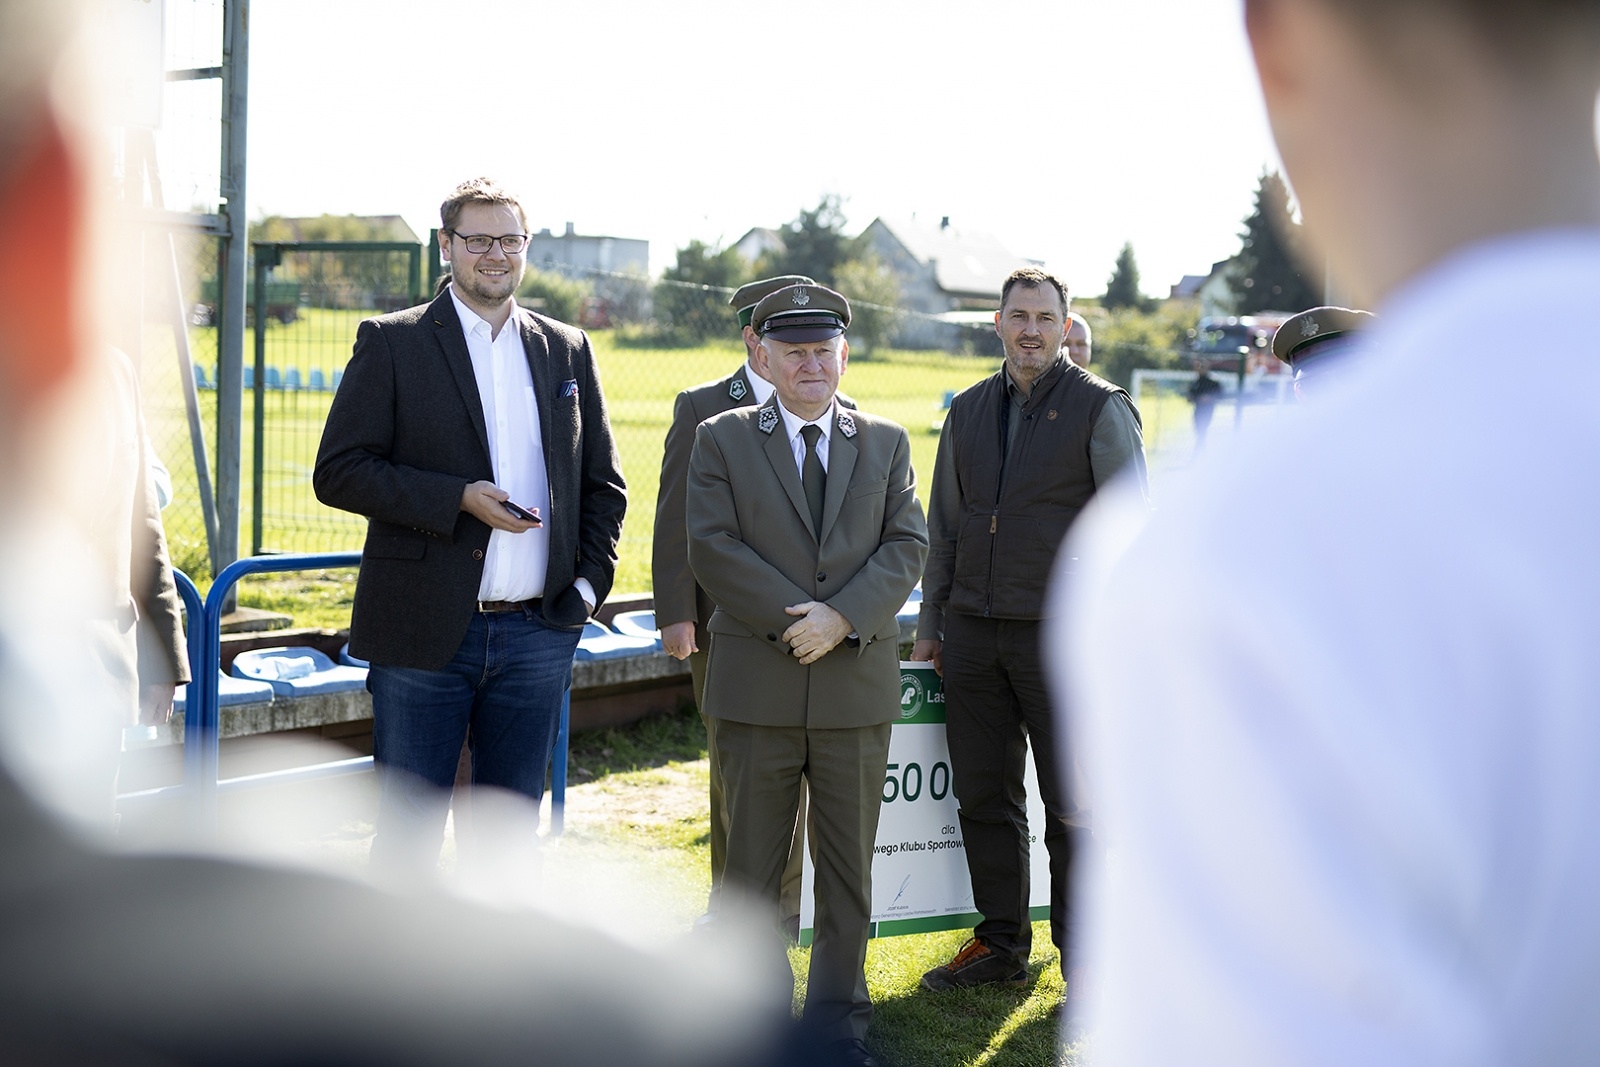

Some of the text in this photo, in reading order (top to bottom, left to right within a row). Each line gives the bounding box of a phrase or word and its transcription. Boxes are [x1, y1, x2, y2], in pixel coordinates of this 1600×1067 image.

[882, 762, 922, 803] 50
[941, 824, 956, 835] dla
[900, 841, 926, 852] Klubu
